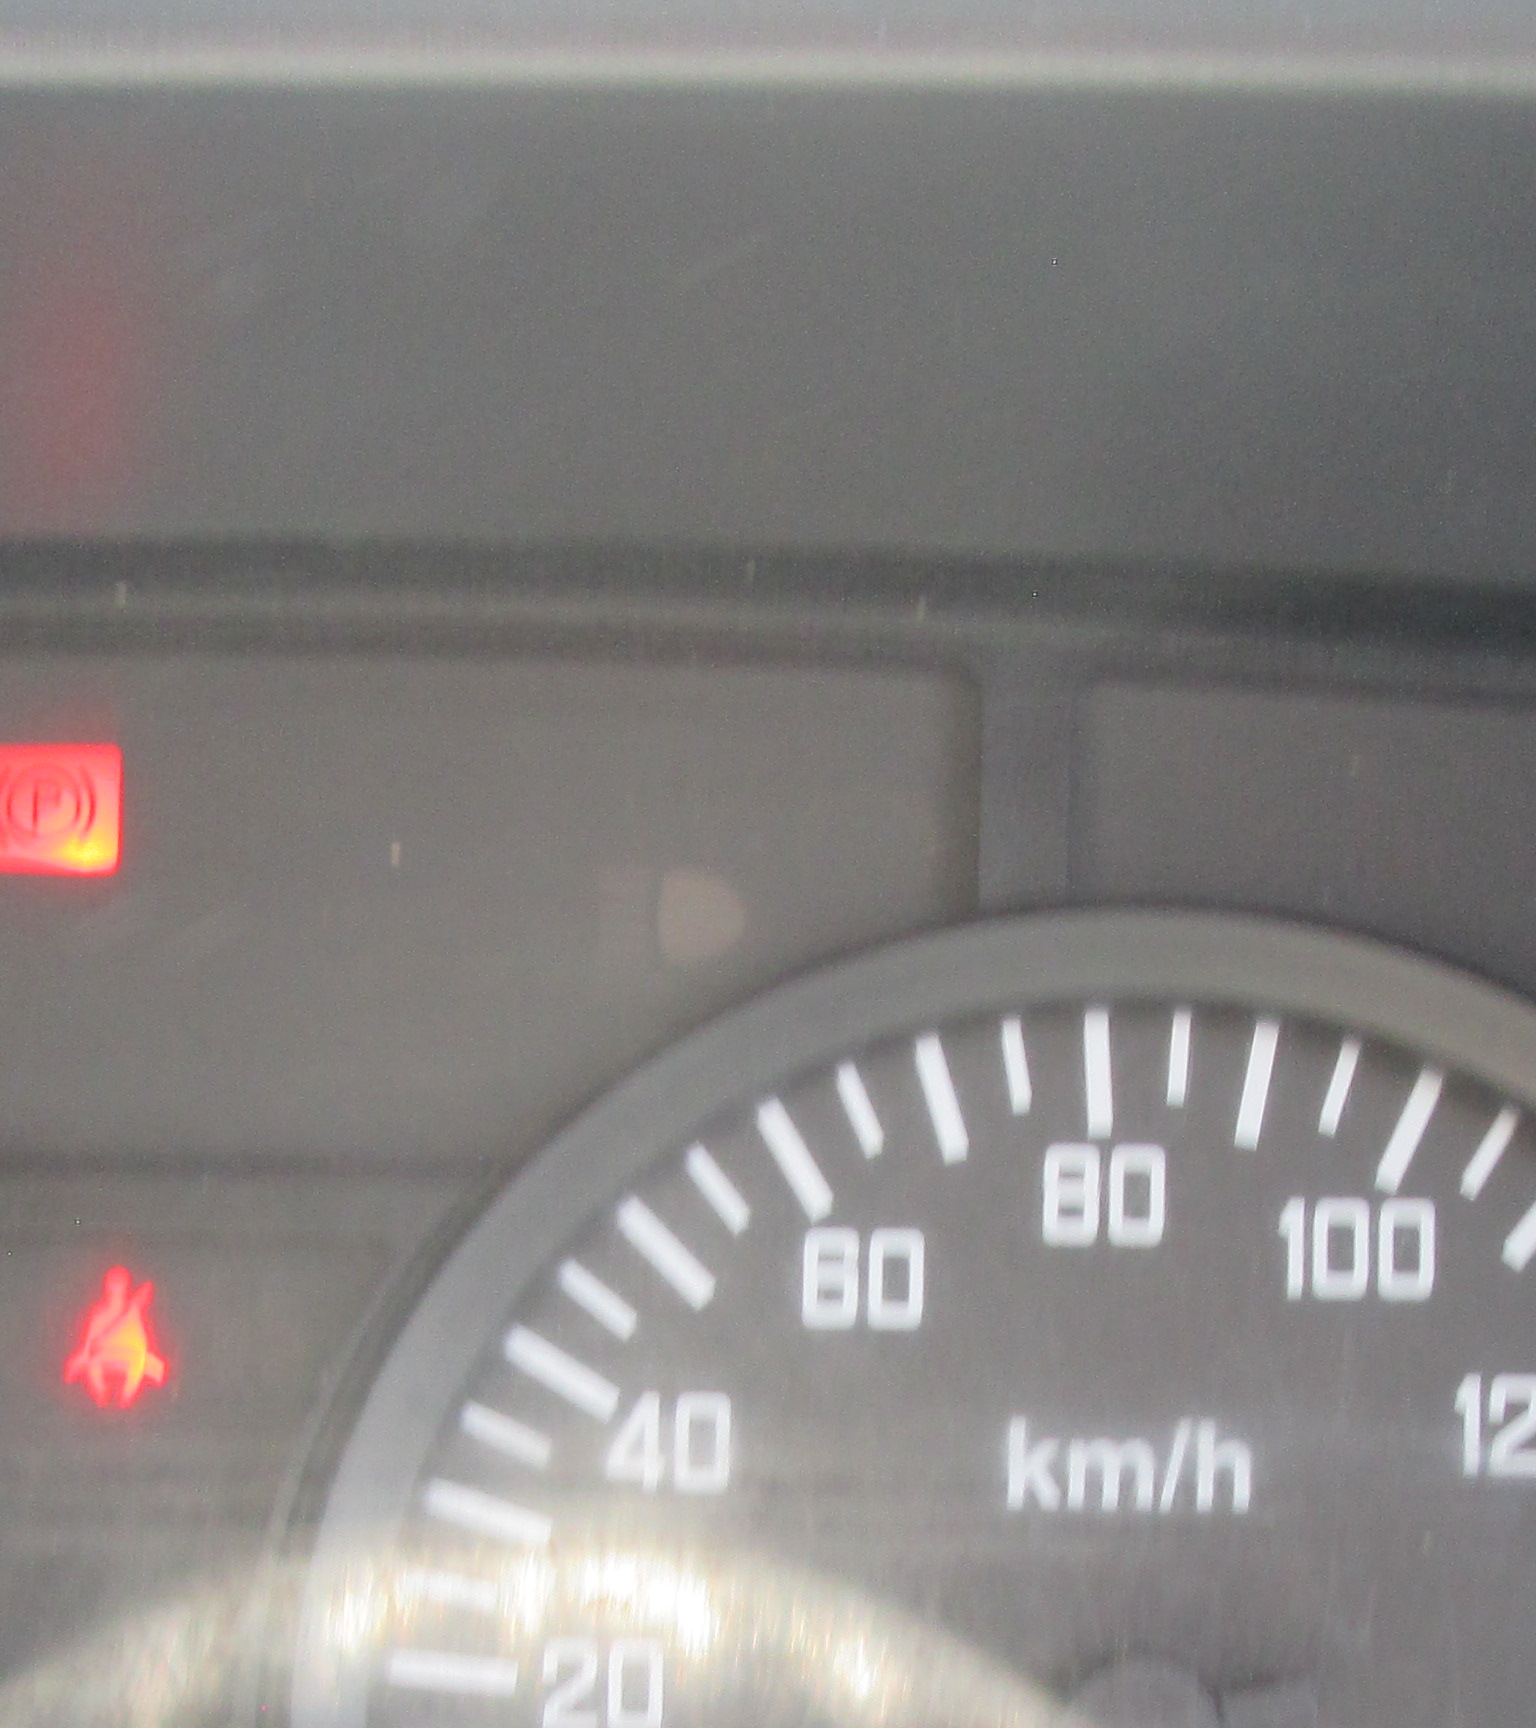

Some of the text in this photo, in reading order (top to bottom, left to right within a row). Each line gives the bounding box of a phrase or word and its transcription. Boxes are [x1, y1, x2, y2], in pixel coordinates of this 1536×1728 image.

[1043, 1143, 1167, 1248] 80
[801, 1228, 925, 1330] 60
[1281, 1197, 1437, 1304] 100
[608, 1391, 731, 1494] 40
[1004, 1416, 1254, 1514] km/h
